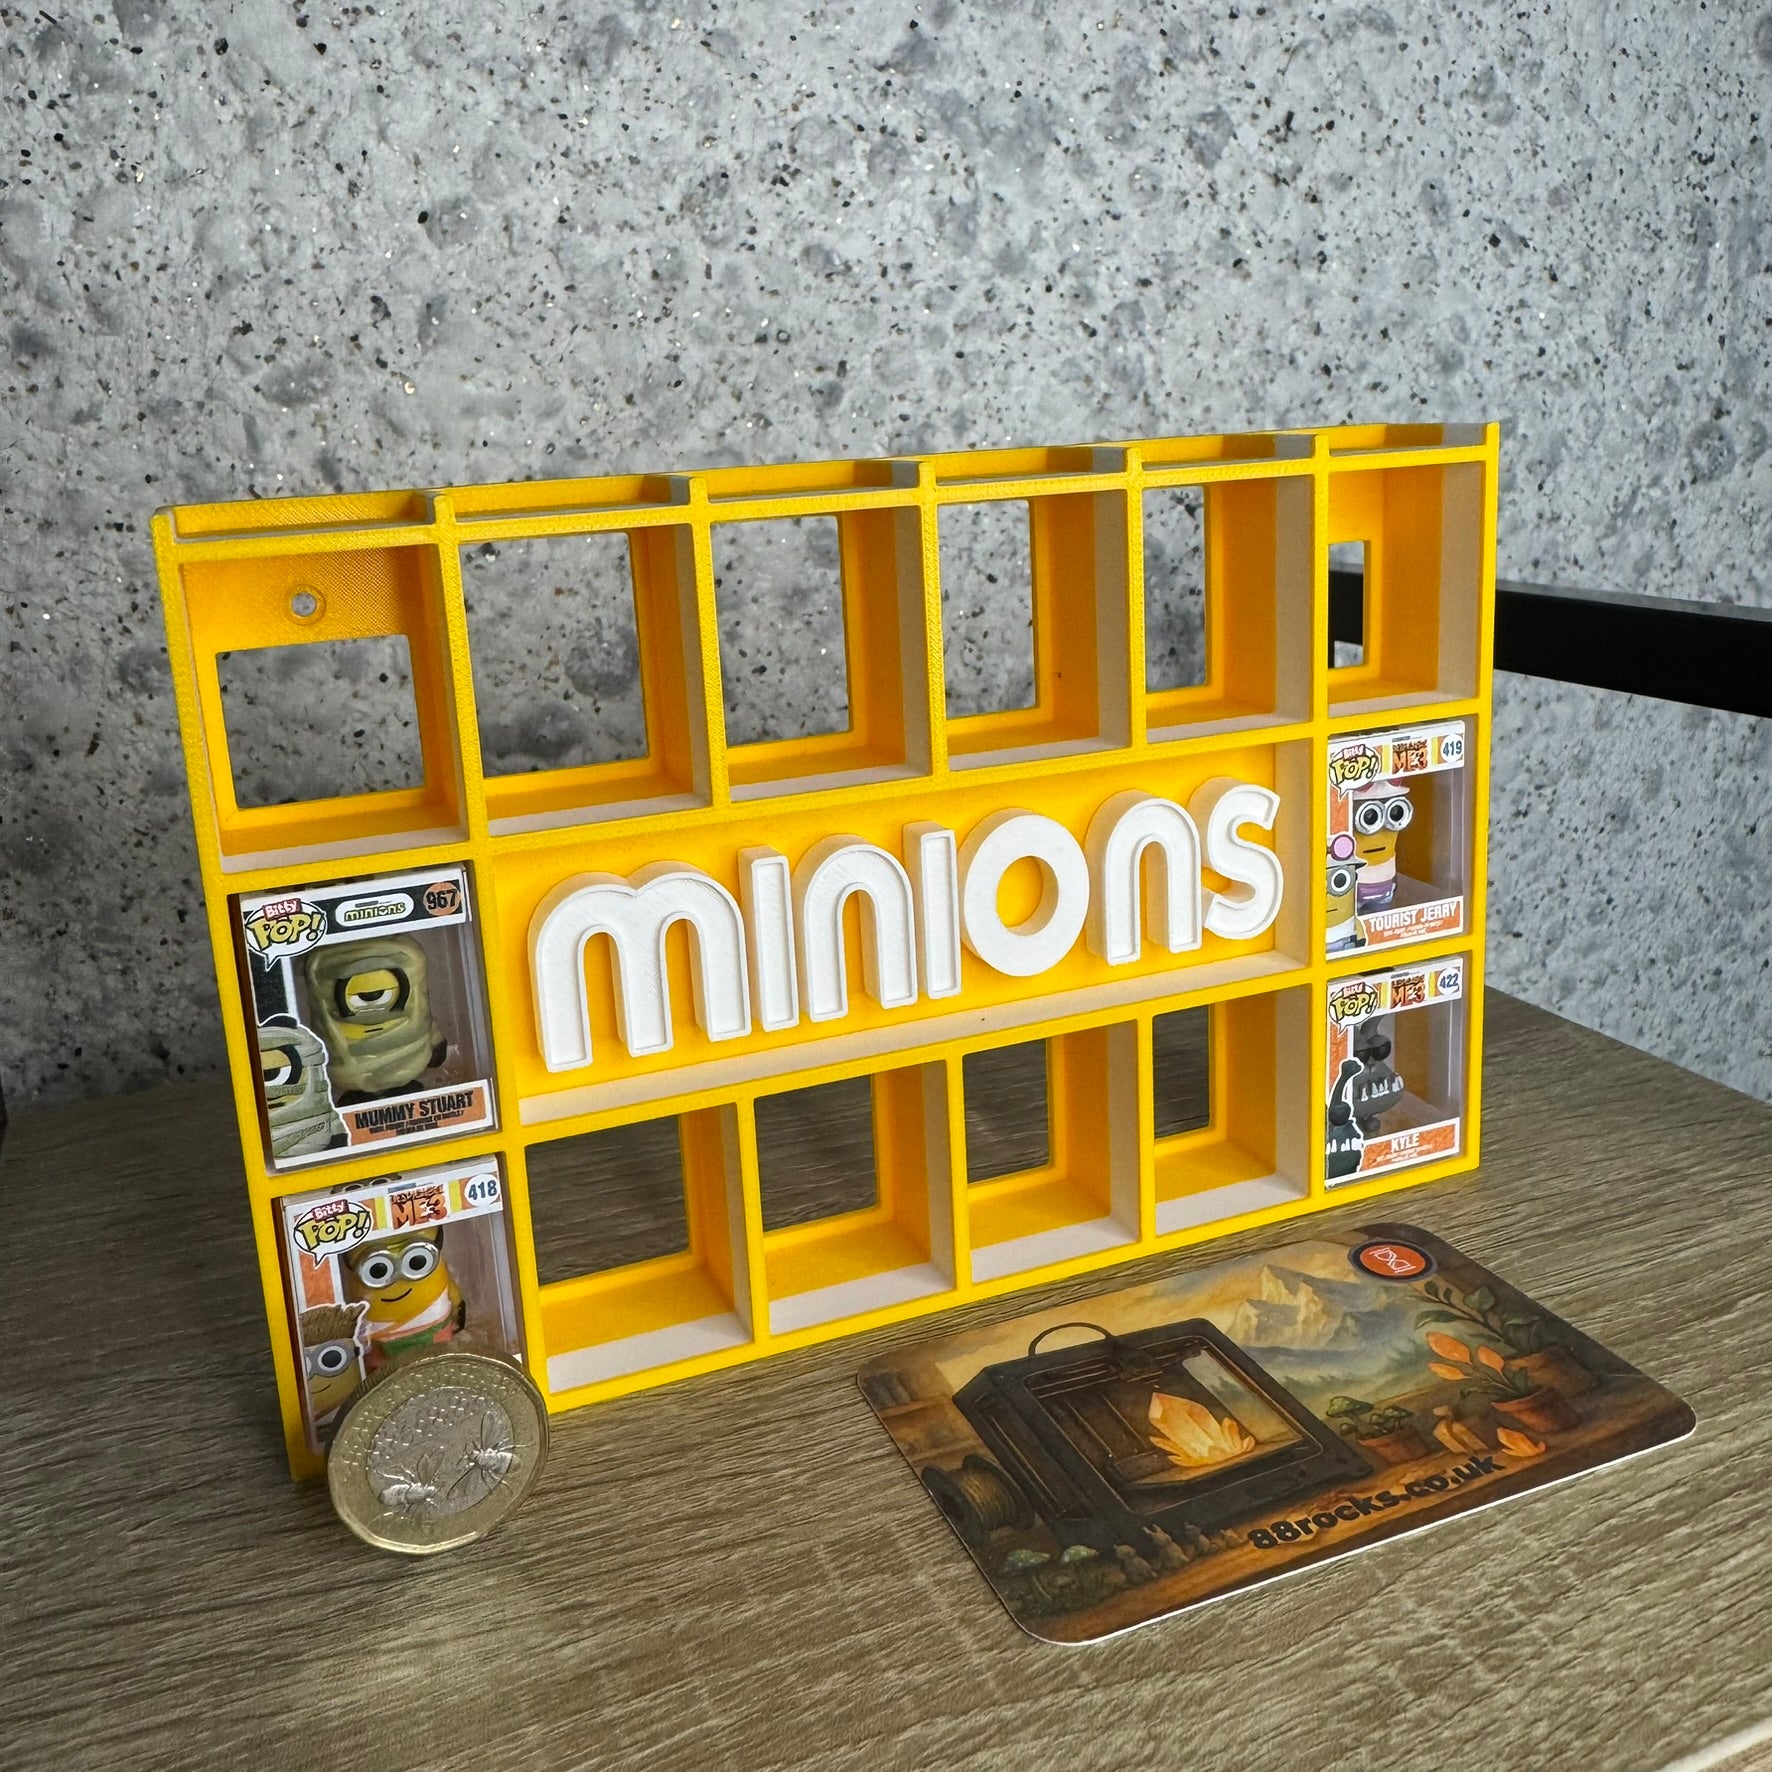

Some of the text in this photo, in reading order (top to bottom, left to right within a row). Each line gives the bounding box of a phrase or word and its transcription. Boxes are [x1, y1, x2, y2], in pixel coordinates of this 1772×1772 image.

[1443, 741, 1463, 757] 419
[1330, 756, 1378, 784] POP!
[344, 902, 407, 922] minions
[528, 778, 1284, 1072] minions
[1369, 909, 1418, 932] TOURIST
[1421, 901, 1457, 922] JERRY
[248, 912, 322, 950] POP!
[1440, 973, 1459, 989] 422
[1330, 992, 1378, 1021] POP!
[355, 1103, 415, 1129] MUMMY
[419, 1090, 473, 1116] STUART
[1391, 1133, 1420, 1153] KYLE
[468, 1180, 498, 1200] 418
[299, 1211, 371, 1250] POP!
[1248, 1455, 1506, 1549] 88rocks.co.uk
